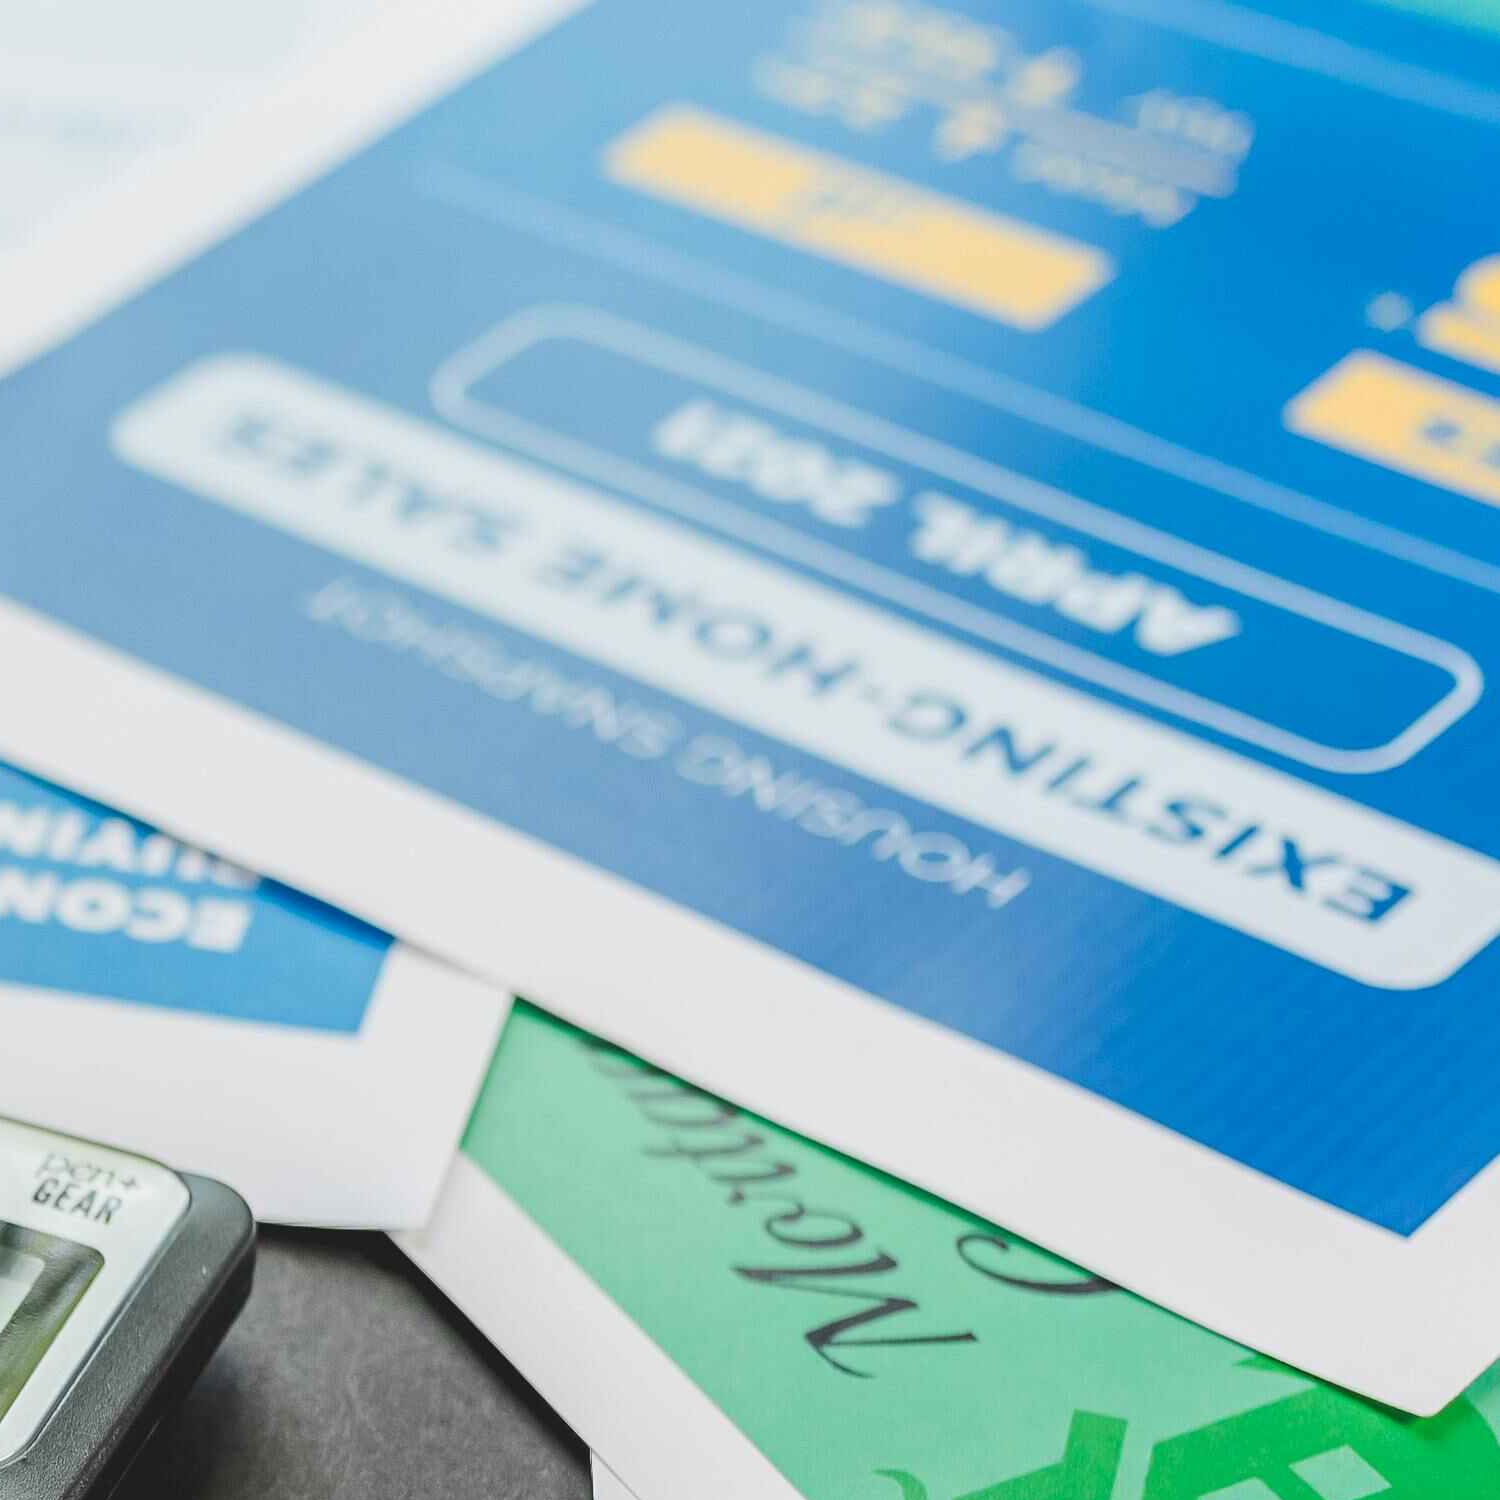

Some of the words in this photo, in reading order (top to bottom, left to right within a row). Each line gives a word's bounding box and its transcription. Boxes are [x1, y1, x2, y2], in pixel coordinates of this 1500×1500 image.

[908, 488, 1244, 657] APRIL
[530, 528, 1417, 926] EXISTING-HOME
[677, 729, 1033, 911] HOUSING
[32, 1178, 123, 1226] GEAR
